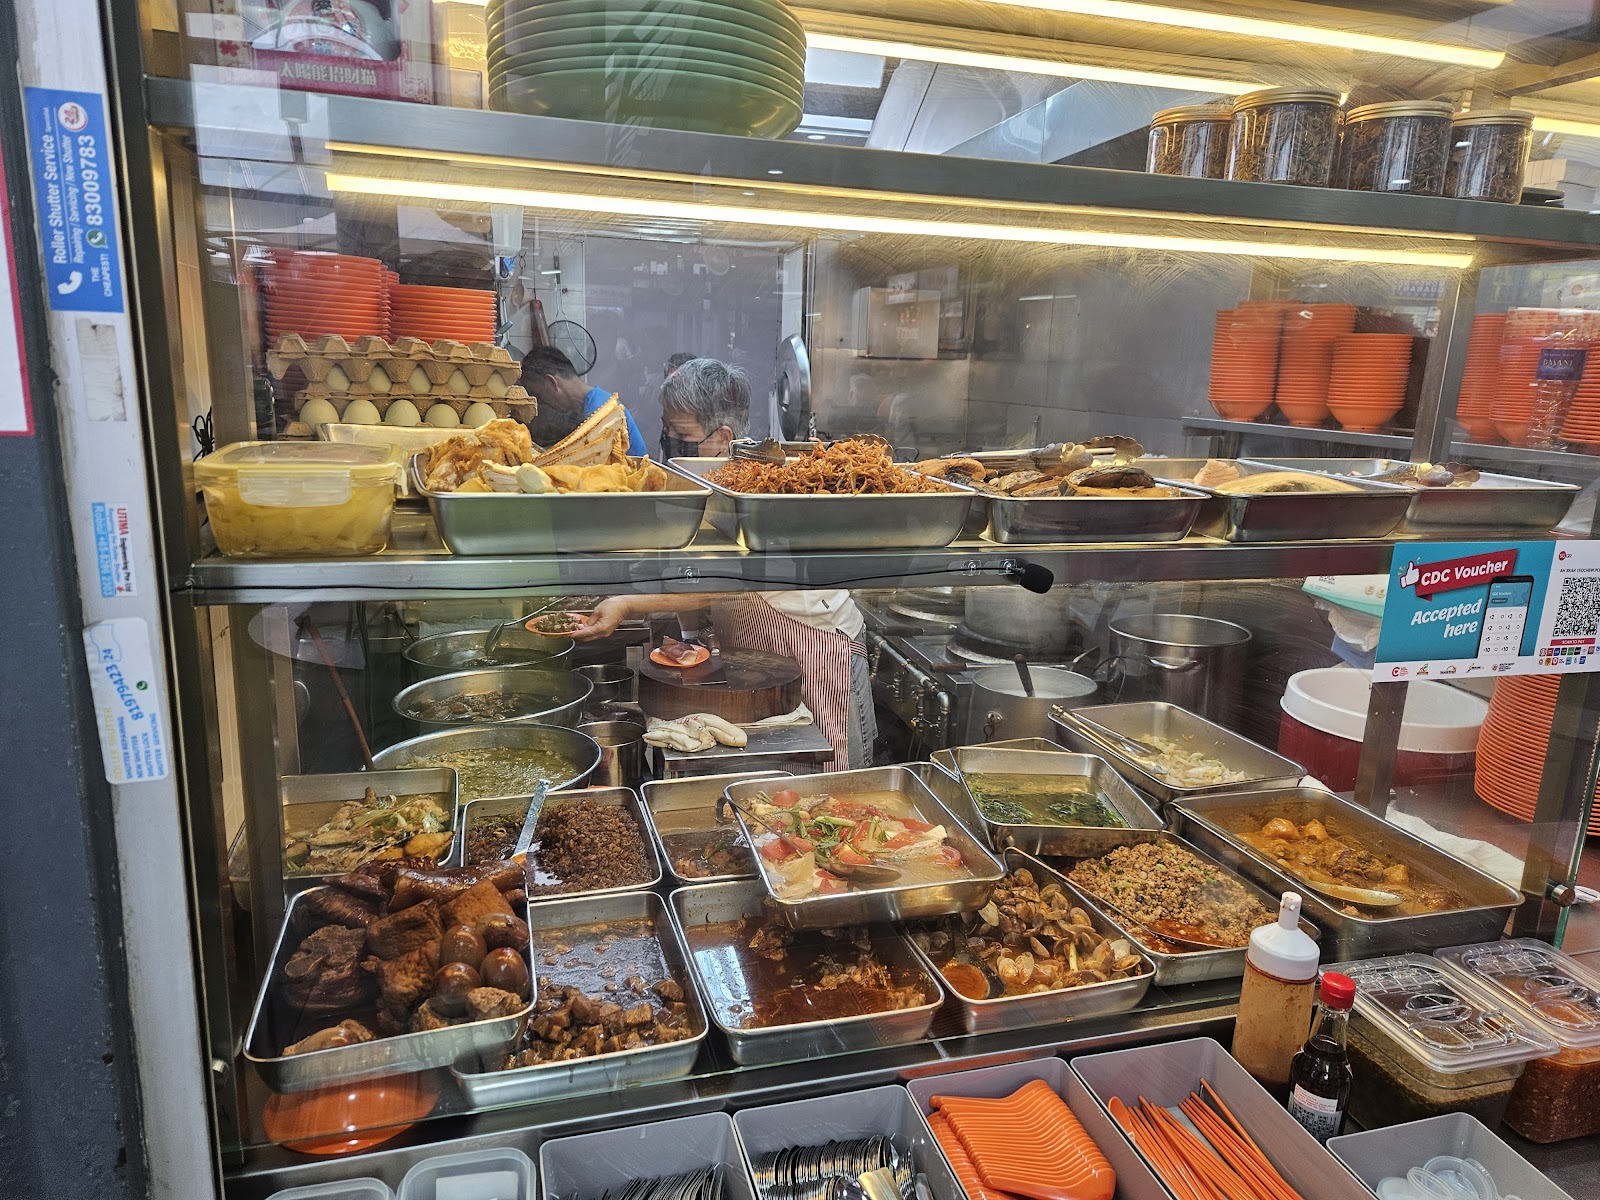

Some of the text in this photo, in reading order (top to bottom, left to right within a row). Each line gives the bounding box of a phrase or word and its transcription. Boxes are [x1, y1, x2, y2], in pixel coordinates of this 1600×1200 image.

[40, 134, 58, 181] Service
[61, 135, 73, 164] Shutter
[63, 164, 75, 181] New
[78, 135, 103, 227] 83009783
[47, 184, 64, 229] Shutter
[64, 186, 80, 222] Servicing
[51, 229, 67, 264] Roller
[68, 227, 84, 264] Repairing
[90, 266, 99, 283] THE
[99, 253, 113, 297] CHEAPEST!
[1542, 358, 1574, 367] DASANI
[1420, 559, 1509, 587] CDC Voucher
[1410, 598, 1483, 626] Accepted
[1443, 620, 1479, 639] here
[102, 648, 114, 660] 24
[105, 664, 144, 721] 81979423
[131, 735, 140, 762] SHUTTER
[142, 732, 154, 777] SHUTTER LOCK
[149, 712, 164, 776] SHUTTER SERVICING
[123, 751, 132, 779] SHUTTER
